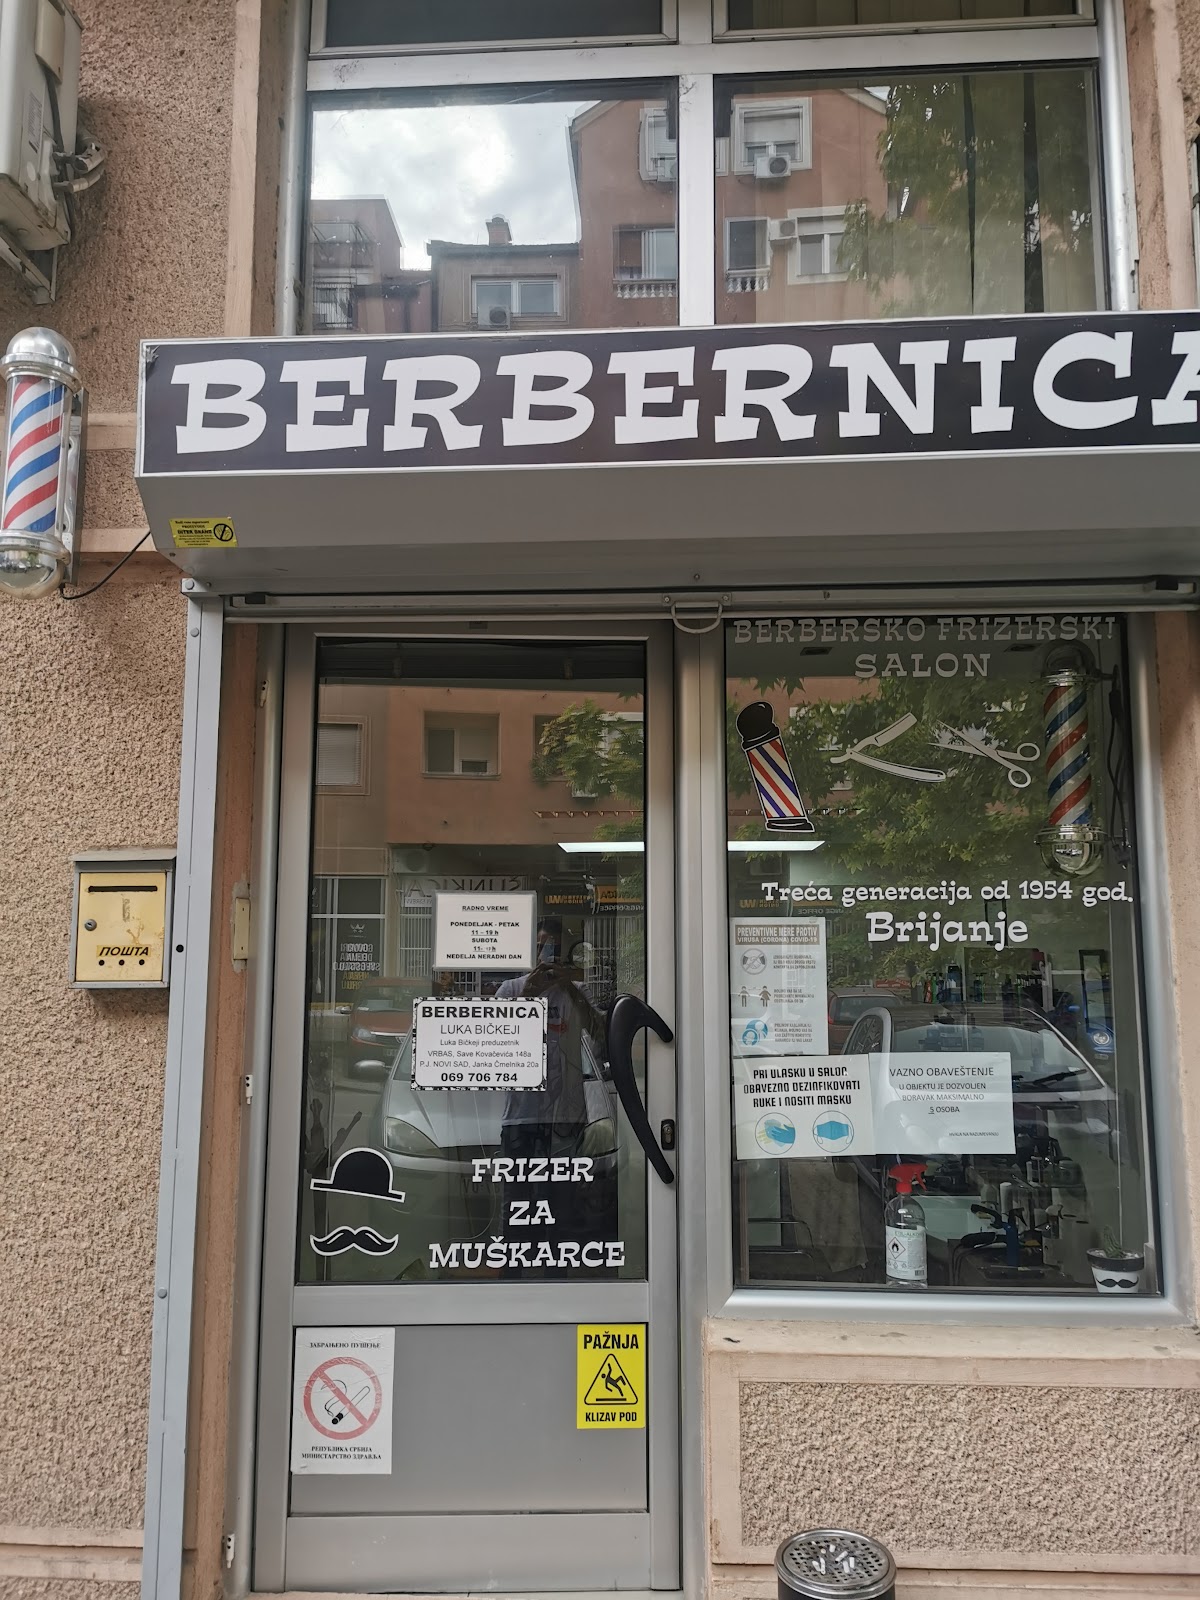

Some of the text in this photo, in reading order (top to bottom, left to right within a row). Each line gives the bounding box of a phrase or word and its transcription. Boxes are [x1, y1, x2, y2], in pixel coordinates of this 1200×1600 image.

[734, 617, 925, 644] BERBERSKO
[855, 653, 991, 678] SALON
[761, 880, 1133, 907] Treća generacija od 1954 god.
[737, 927, 778, 937] PREVENTIVNE
[796, 927, 818, 937] PROTIV
[865, 911, 1029, 951] Brijanje
[98, 946, 149, 956] ПОШТА
[421, 1006, 540, 1019] BERBERNICA
[440, 1023, 520, 1035] LUKA BIČKEJI
[458, 1039, 480, 1047] Bičkeji
[481, 1039, 520, 1047] preduzetnik
[427, 1050, 455, 1058] VRBAS,
[494, 1060, 525, 1068] Čmelnika
[441, 1072, 518, 1082] 069 706 784
[753, 1069, 768, 1079] PRI
[770, 1067, 806, 1079] ULASKU
[808, 1067, 815, 1077] U
[889, 1065, 994, 1077] VAZNO OBAVEŠTENJE
[743, 1080, 861, 1094] OBAVEZNO DEZINFIKOVATI
[753, 1094, 852, 1108] RUKE I NOSITI MASKU
[936, 1093, 985, 1101] MAKSIMALNO
[471, 1156, 594, 1183] FRIZER
[508, 1199, 556, 1226] ZA
[429, 1236, 626, 1269] MUŠKARCE
[583, 1330, 639, 1349] PAŽNJA
[585, 1411, 637, 1422] KLIZAV POD
[301, 1452, 351, 1460] МИНИСТАРСТВО
